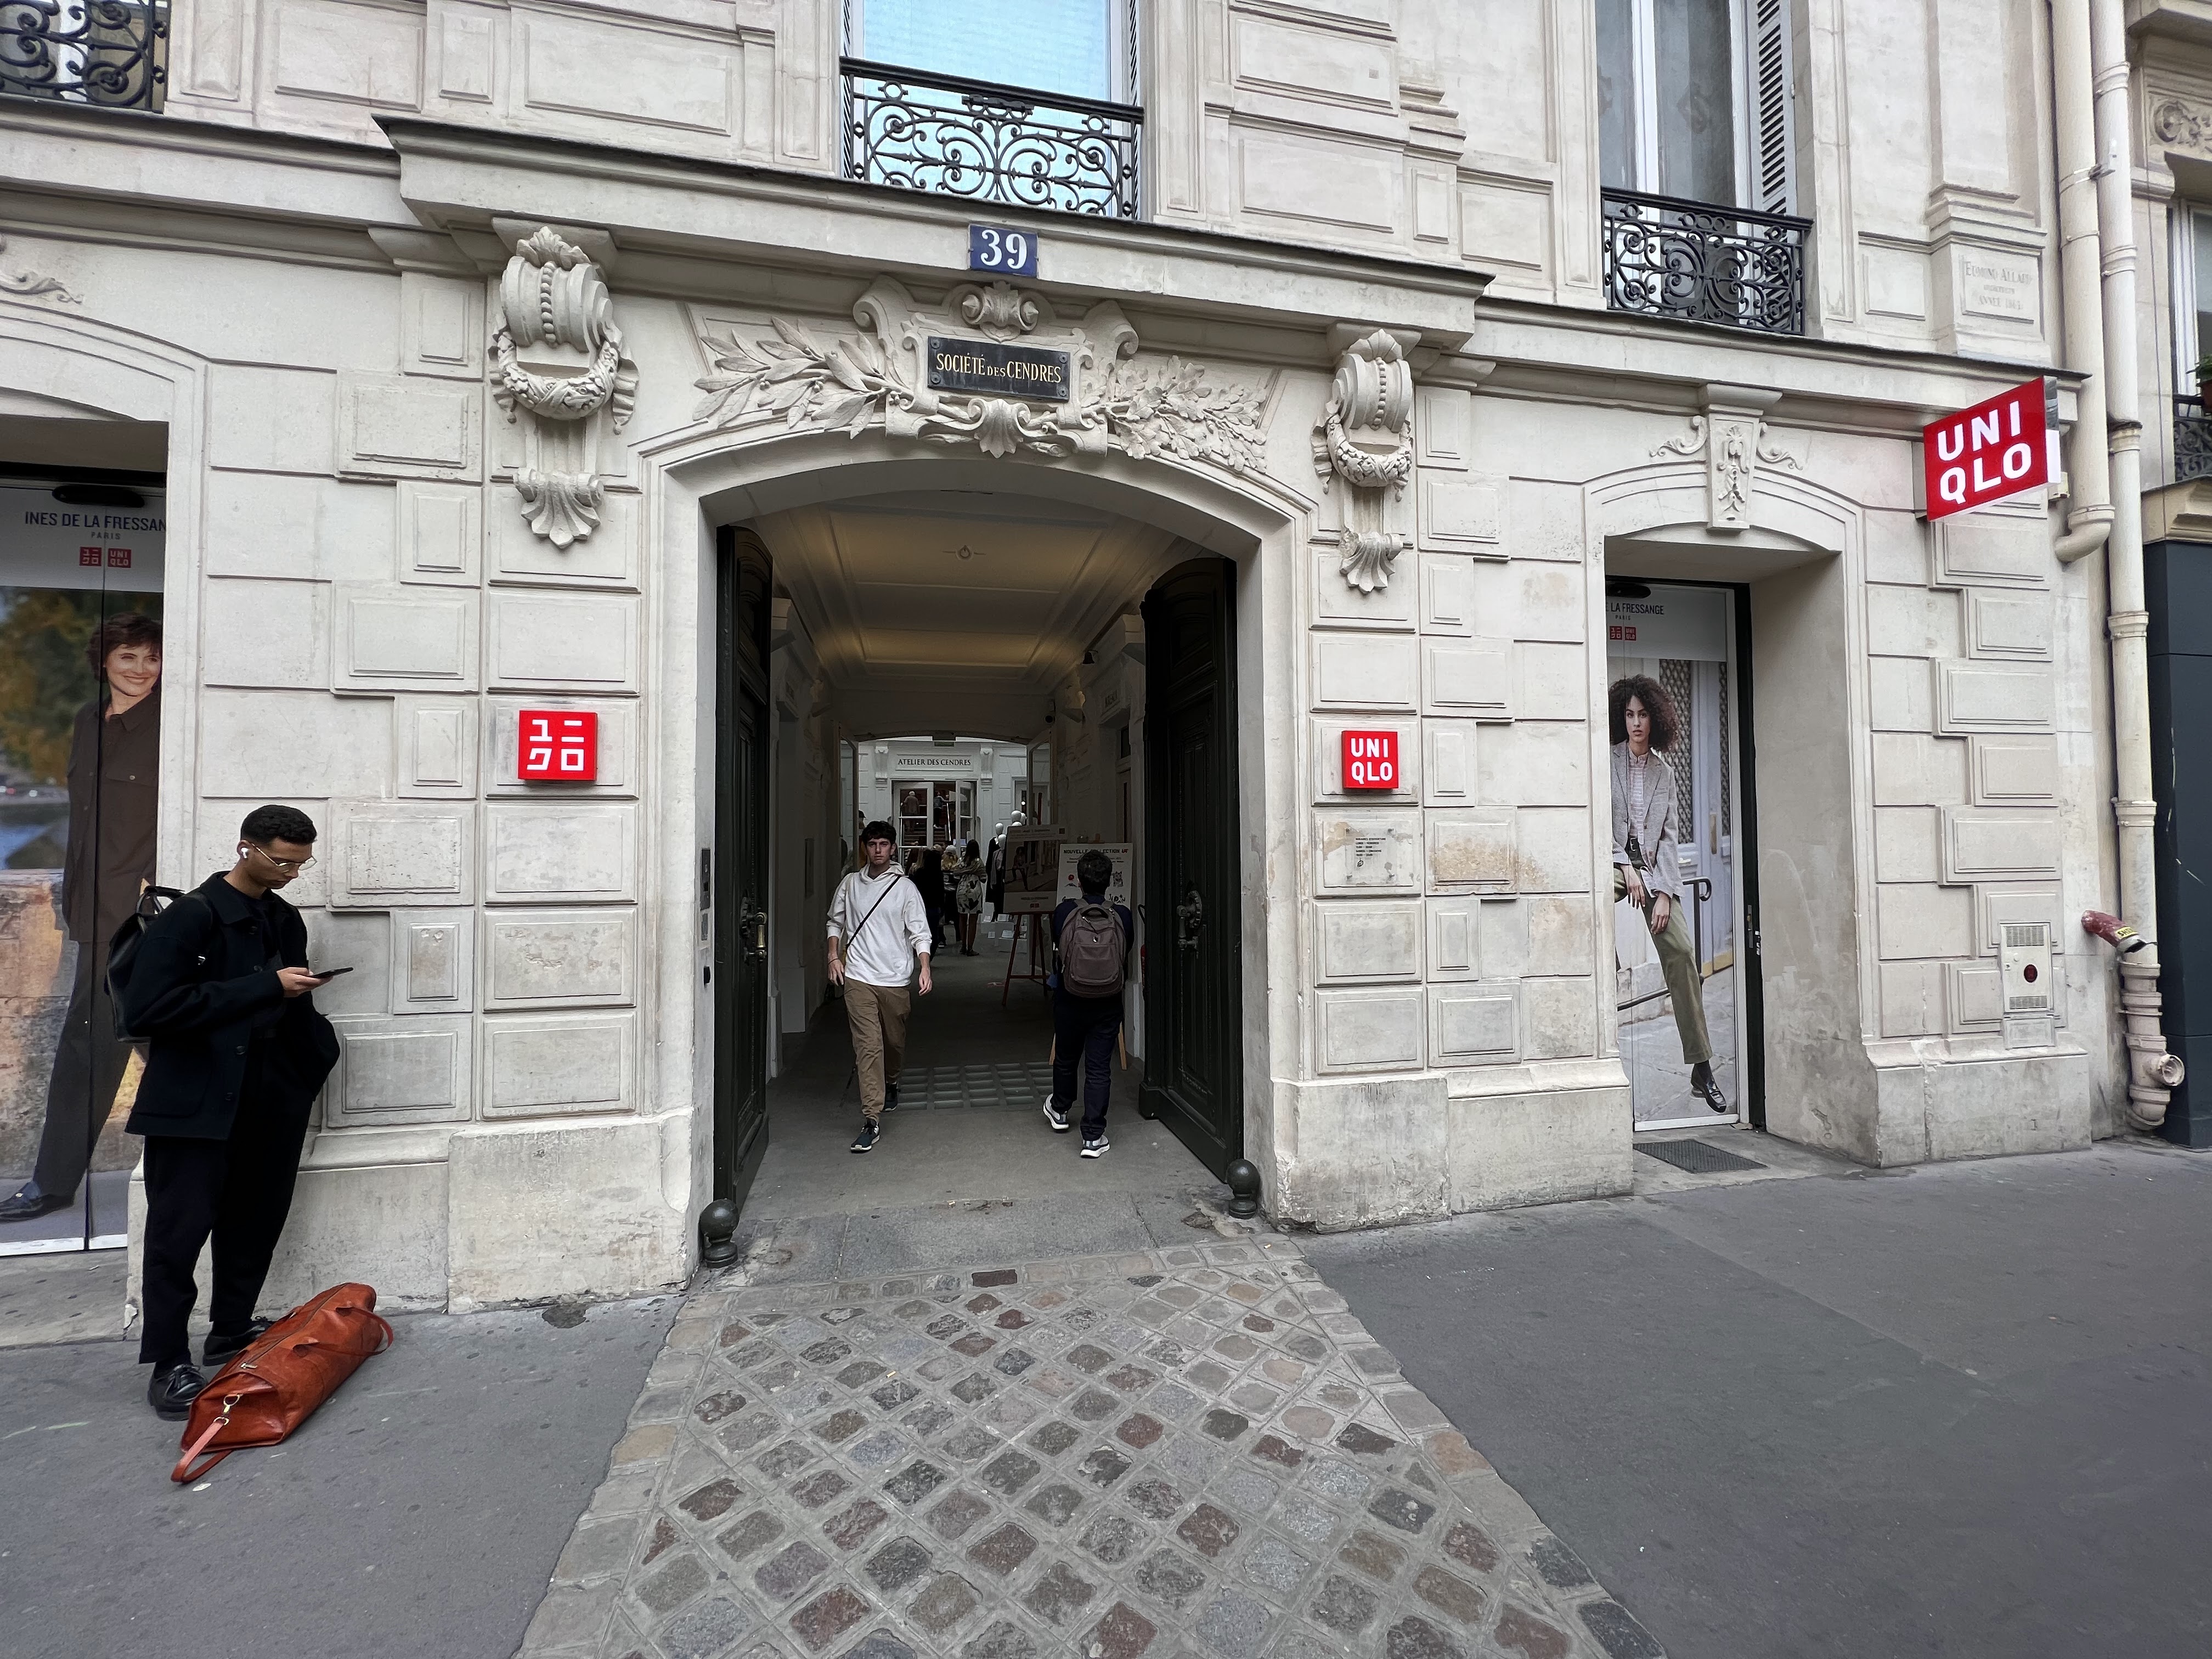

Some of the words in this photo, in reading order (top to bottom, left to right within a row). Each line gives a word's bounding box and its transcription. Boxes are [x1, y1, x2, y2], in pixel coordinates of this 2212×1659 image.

[980, 229, 1028, 270] 39
[936, 353, 986, 376] SOCIÉTÉ
[1007, 361, 1062, 383] CENDRES
[1937, 400, 2021, 461] UNI
[1940, 443, 2032, 505] QLO
[25, 511, 58, 527] INES
[61, 513, 80, 527] DE
[84, 515, 100, 528] LA
[91, 531, 122, 540] PARIS
[1611, 602, 1621, 612] LA
[1622, 603, 1664, 615] FRESSANGE
[1351, 738, 1389, 758] UNI
[1351, 761, 1393, 785] QLO
